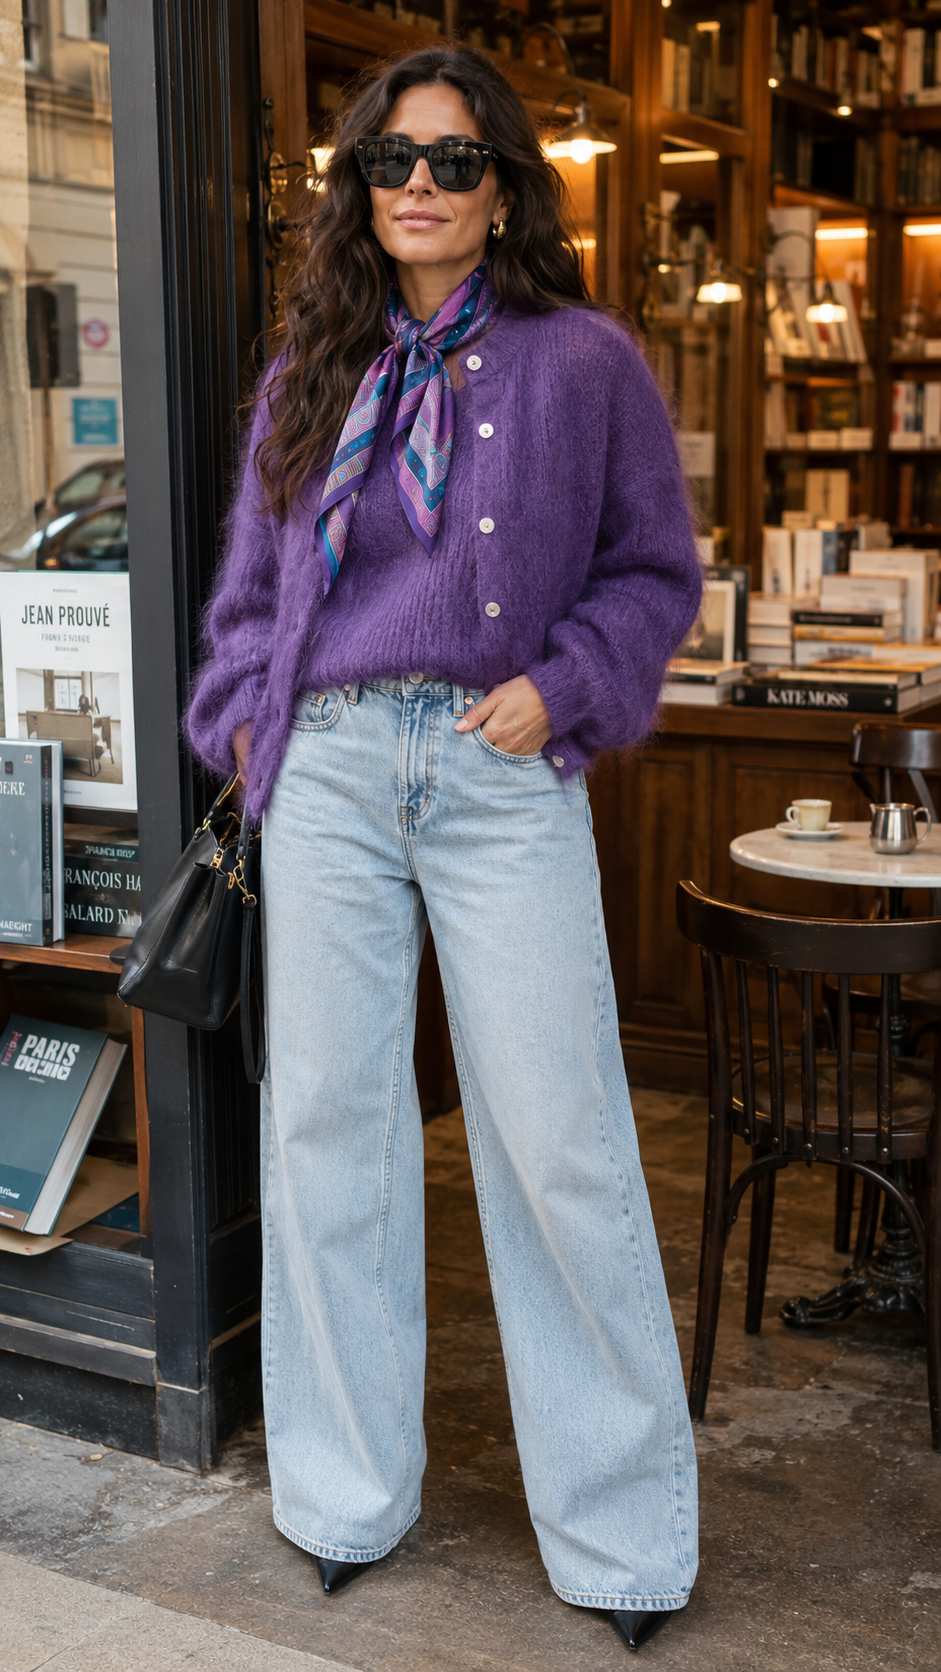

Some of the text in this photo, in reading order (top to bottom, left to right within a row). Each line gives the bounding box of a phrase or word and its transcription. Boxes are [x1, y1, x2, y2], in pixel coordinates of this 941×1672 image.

[21, 602, 111, 628] JEAN PROUVÉ
[767, 688, 807, 706] KATE
[808, 690, 849, 709] MOSS
[64, 866, 122, 891] RANÇOIS
[21, 1033, 80, 1067] PARIS
